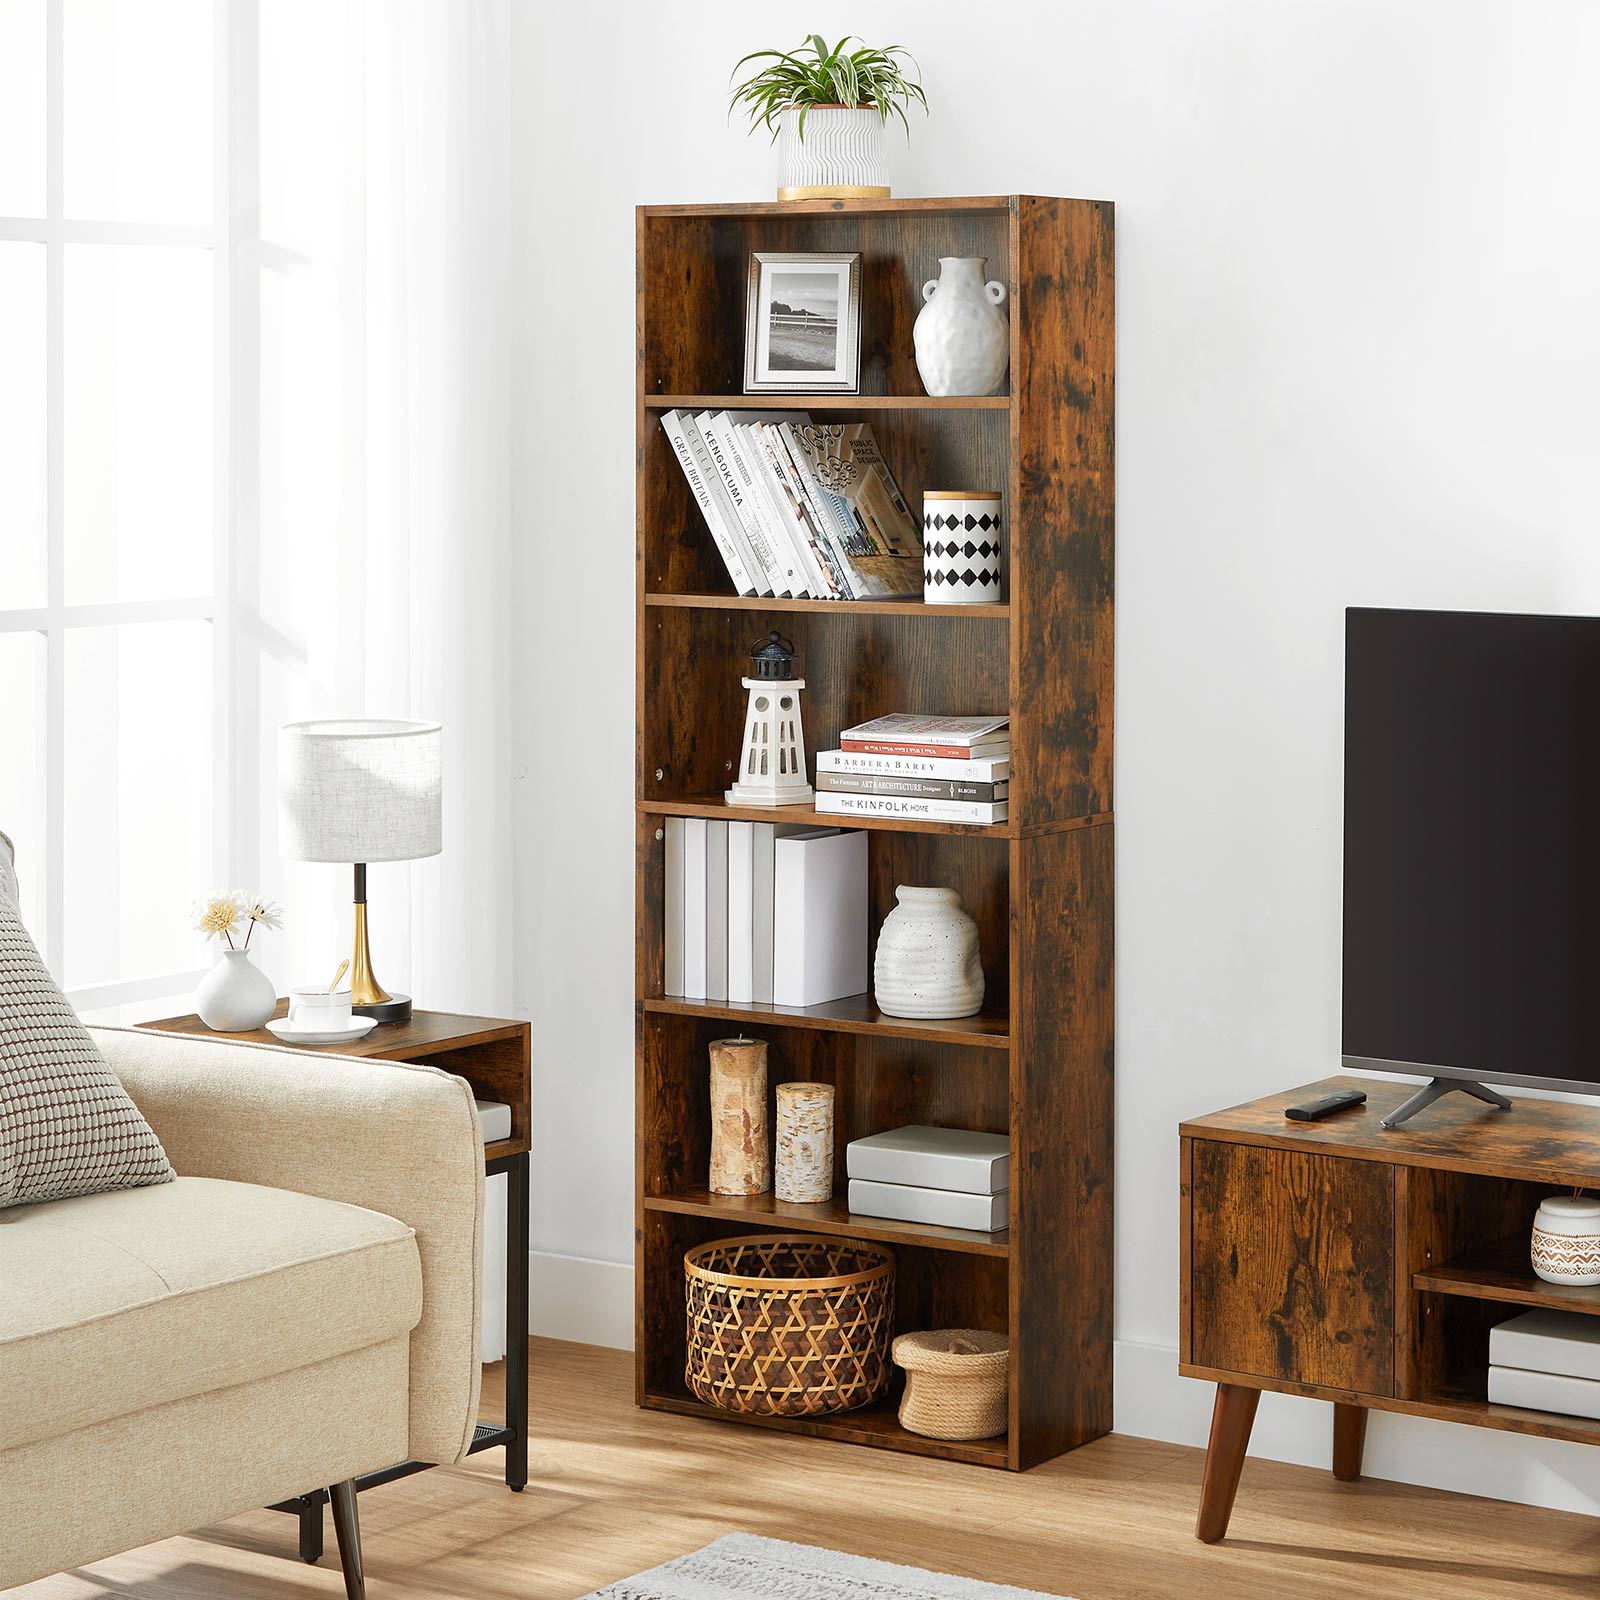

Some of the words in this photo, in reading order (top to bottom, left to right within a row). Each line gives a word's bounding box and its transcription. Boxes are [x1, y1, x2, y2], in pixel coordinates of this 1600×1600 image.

[674, 436, 693, 467] GREAT
[688, 467, 711, 508] BRITAIN
[687, 429, 716, 482] CEREAL
[704, 430, 744, 507] KENGOKUMA
[791, 448, 809, 481] PUBLIC
[805, 478, 821, 511] SPACE
[817, 509, 837, 545] DESIGN
[834, 757, 890, 768] BARBERA
[895, 761, 936, 772] BAREY
[922, 786, 942, 794] Designer
[841, 799, 854, 808] THE
[856, 800, 909, 812] KINFOLK
[910, 804, 929, 812] HOME
